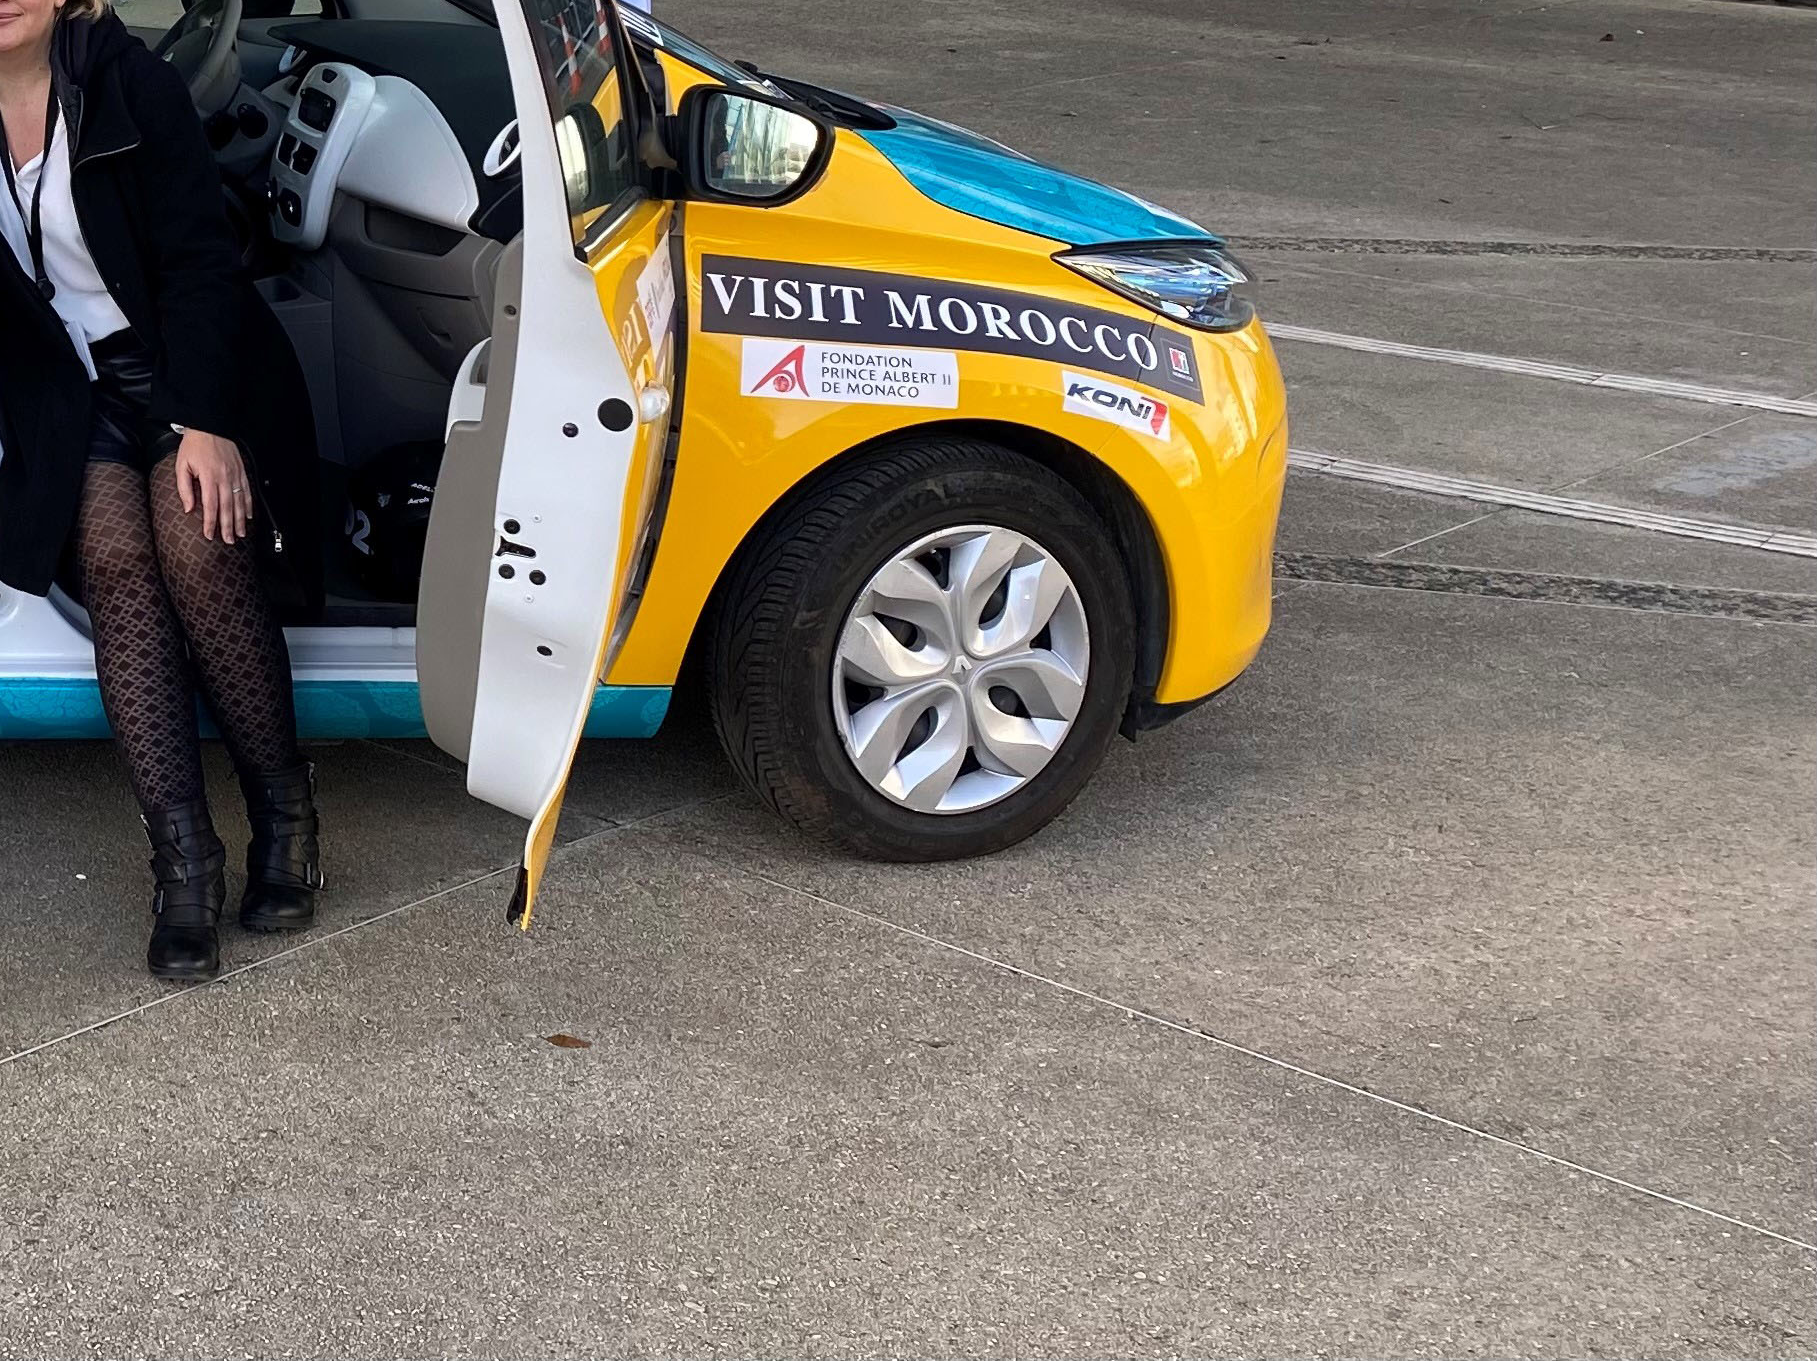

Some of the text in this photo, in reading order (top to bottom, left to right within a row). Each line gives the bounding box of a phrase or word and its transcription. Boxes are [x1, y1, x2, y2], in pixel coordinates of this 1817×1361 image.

[706, 272, 865, 325] VISIT
[883, 290, 1159, 371] MOROCCO
[821, 351, 913, 369] FONDATION
[821, 366, 952, 386] PRINCE ALBERT II
[821, 381, 920, 399] DE MONACO
[1066, 383, 1153, 420] KONI
